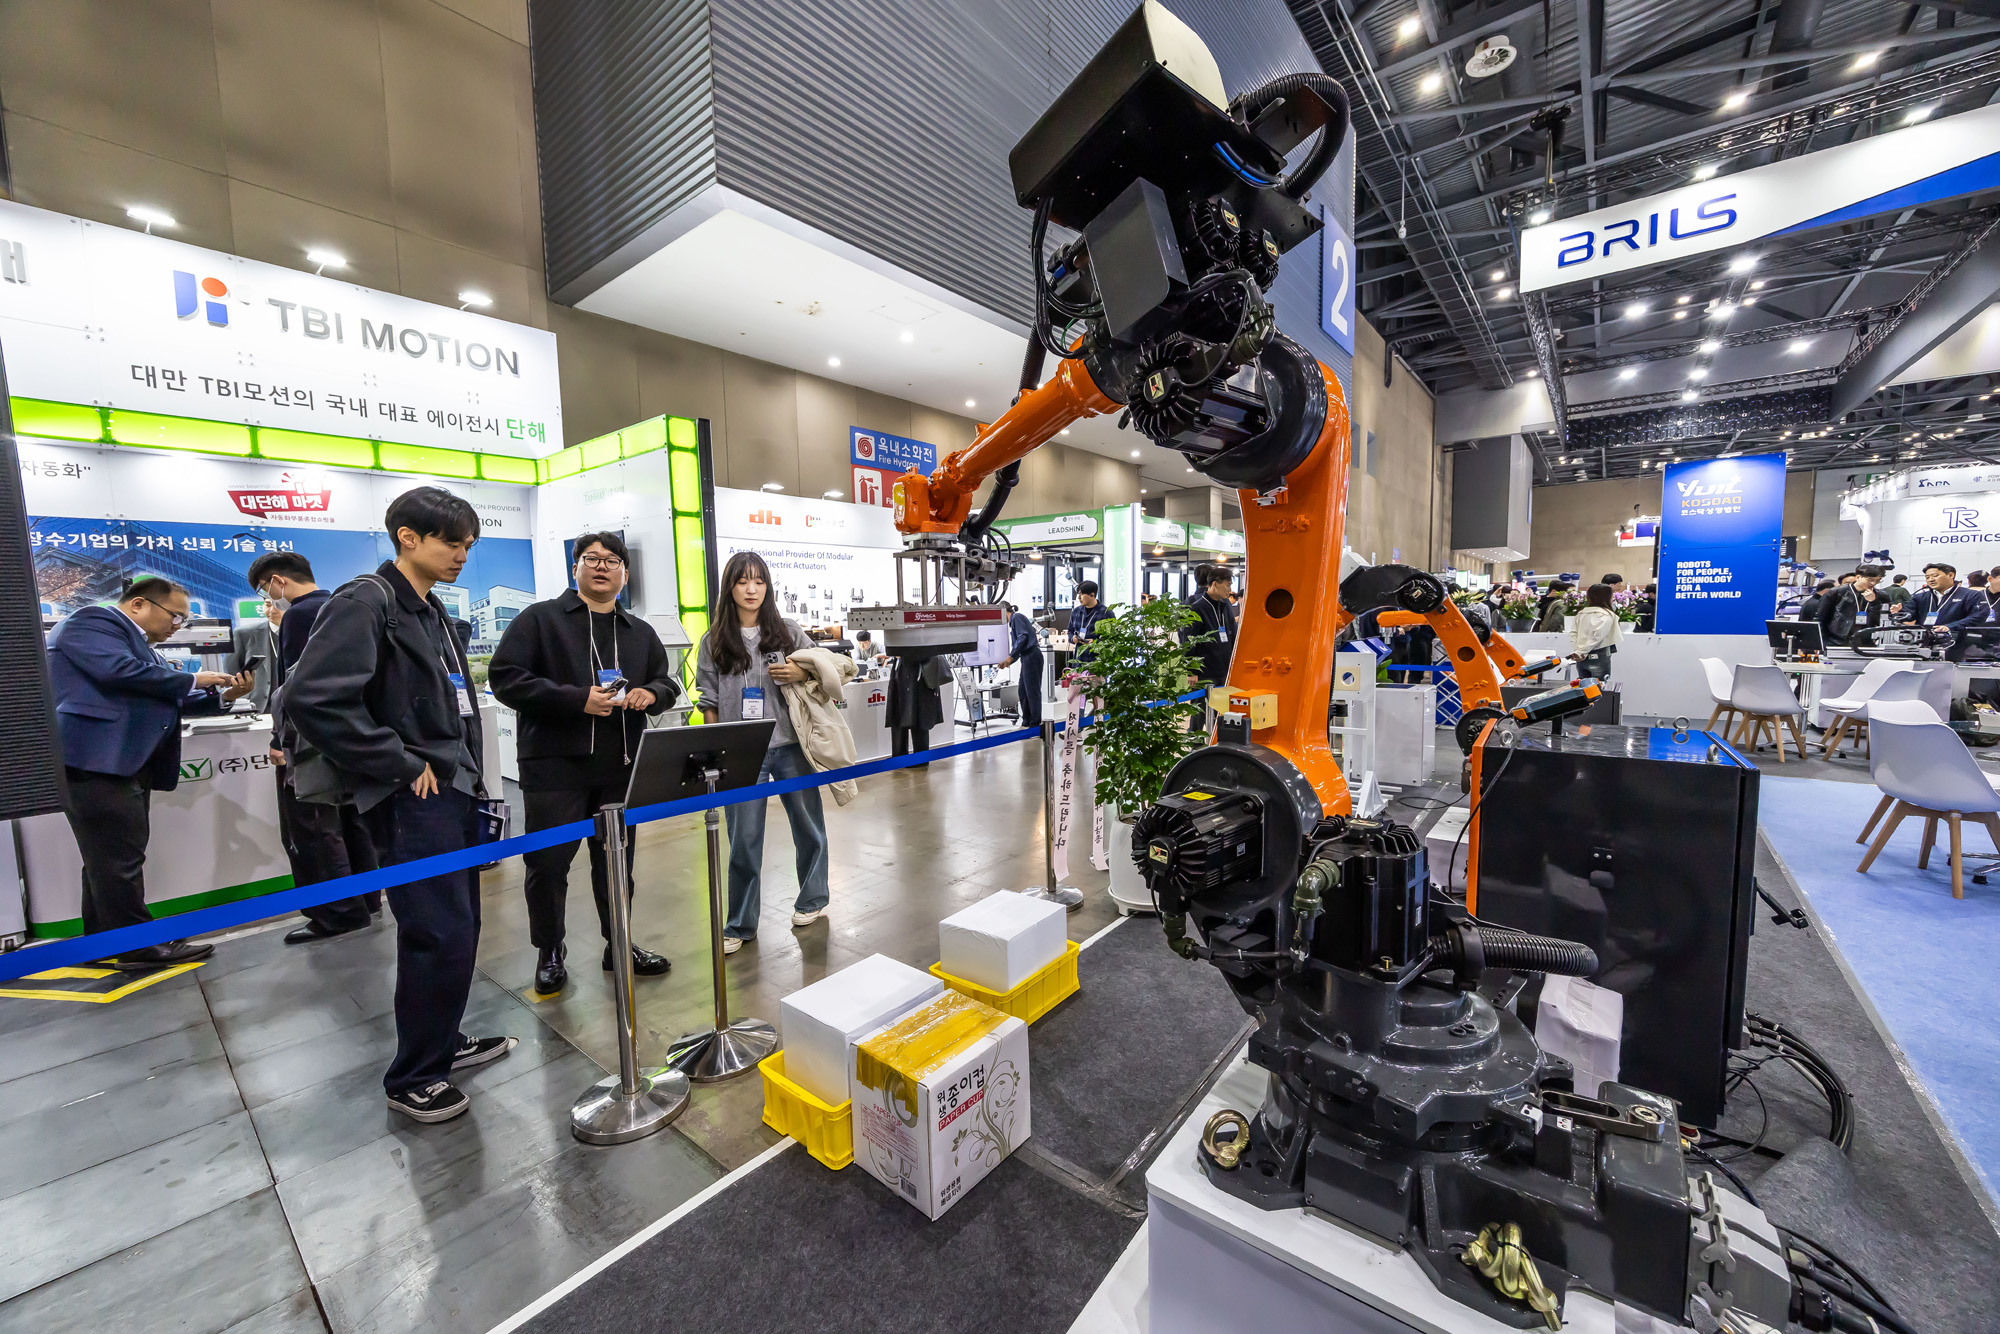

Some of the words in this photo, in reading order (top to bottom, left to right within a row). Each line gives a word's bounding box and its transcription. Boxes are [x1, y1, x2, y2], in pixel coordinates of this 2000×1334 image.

[1558, 193, 1737, 269] BRILS
[1331, 239, 1349, 336] 2
[267, 298, 343, 344] TBI
[360, 318, 520, 378] MOTION
[131, 364, 187, 392] 대만
[198, 376, 314, 411] TBI모션의
[325, 393, 368, 419] 국내
[378, 402, 418, 423] 대표
[427, 409, 499, 436] 에이전시
[506, 418, 546, 444] 단해
[878, 437, 932, 463] 옥내소화전
[878, 454, 892, 465] Fire
[893, 459, 921, 471] Hydrant
[239, 495, 289, 510] 대단해
[487, 504, 521, 512] PROVIDER
[1681, 496, 1742, 508] KOSDAQ
[1048, 525, 1085, 535] LEADSHINE
[136, 535, 174, 550] 가치
[181, 537, 216, 552] 신뢰
[222, 539, 256, 553] 기술
[262, 540, 294, 553] 혁신
[1916, 533, 2000, 545] T-ROBOTICS
[785, 550, 815, 559] Provider
[826, 552, 853, 561] Modular
[793, 562, 826, 570] Actuators
[1677, 561, 1711, 569] ROBOTS
[1696, 568, 1732, 576] PEOPLE,
[1677, 576, 1732, 584] TECHNOLOGY
[947, 1064, 985, 1108] 종이컵
[873, 1103, 891, 1119] PAPER
[939, 1104, 967, 1130] PAPER
[967, 1090, 984, 1107] CUP
